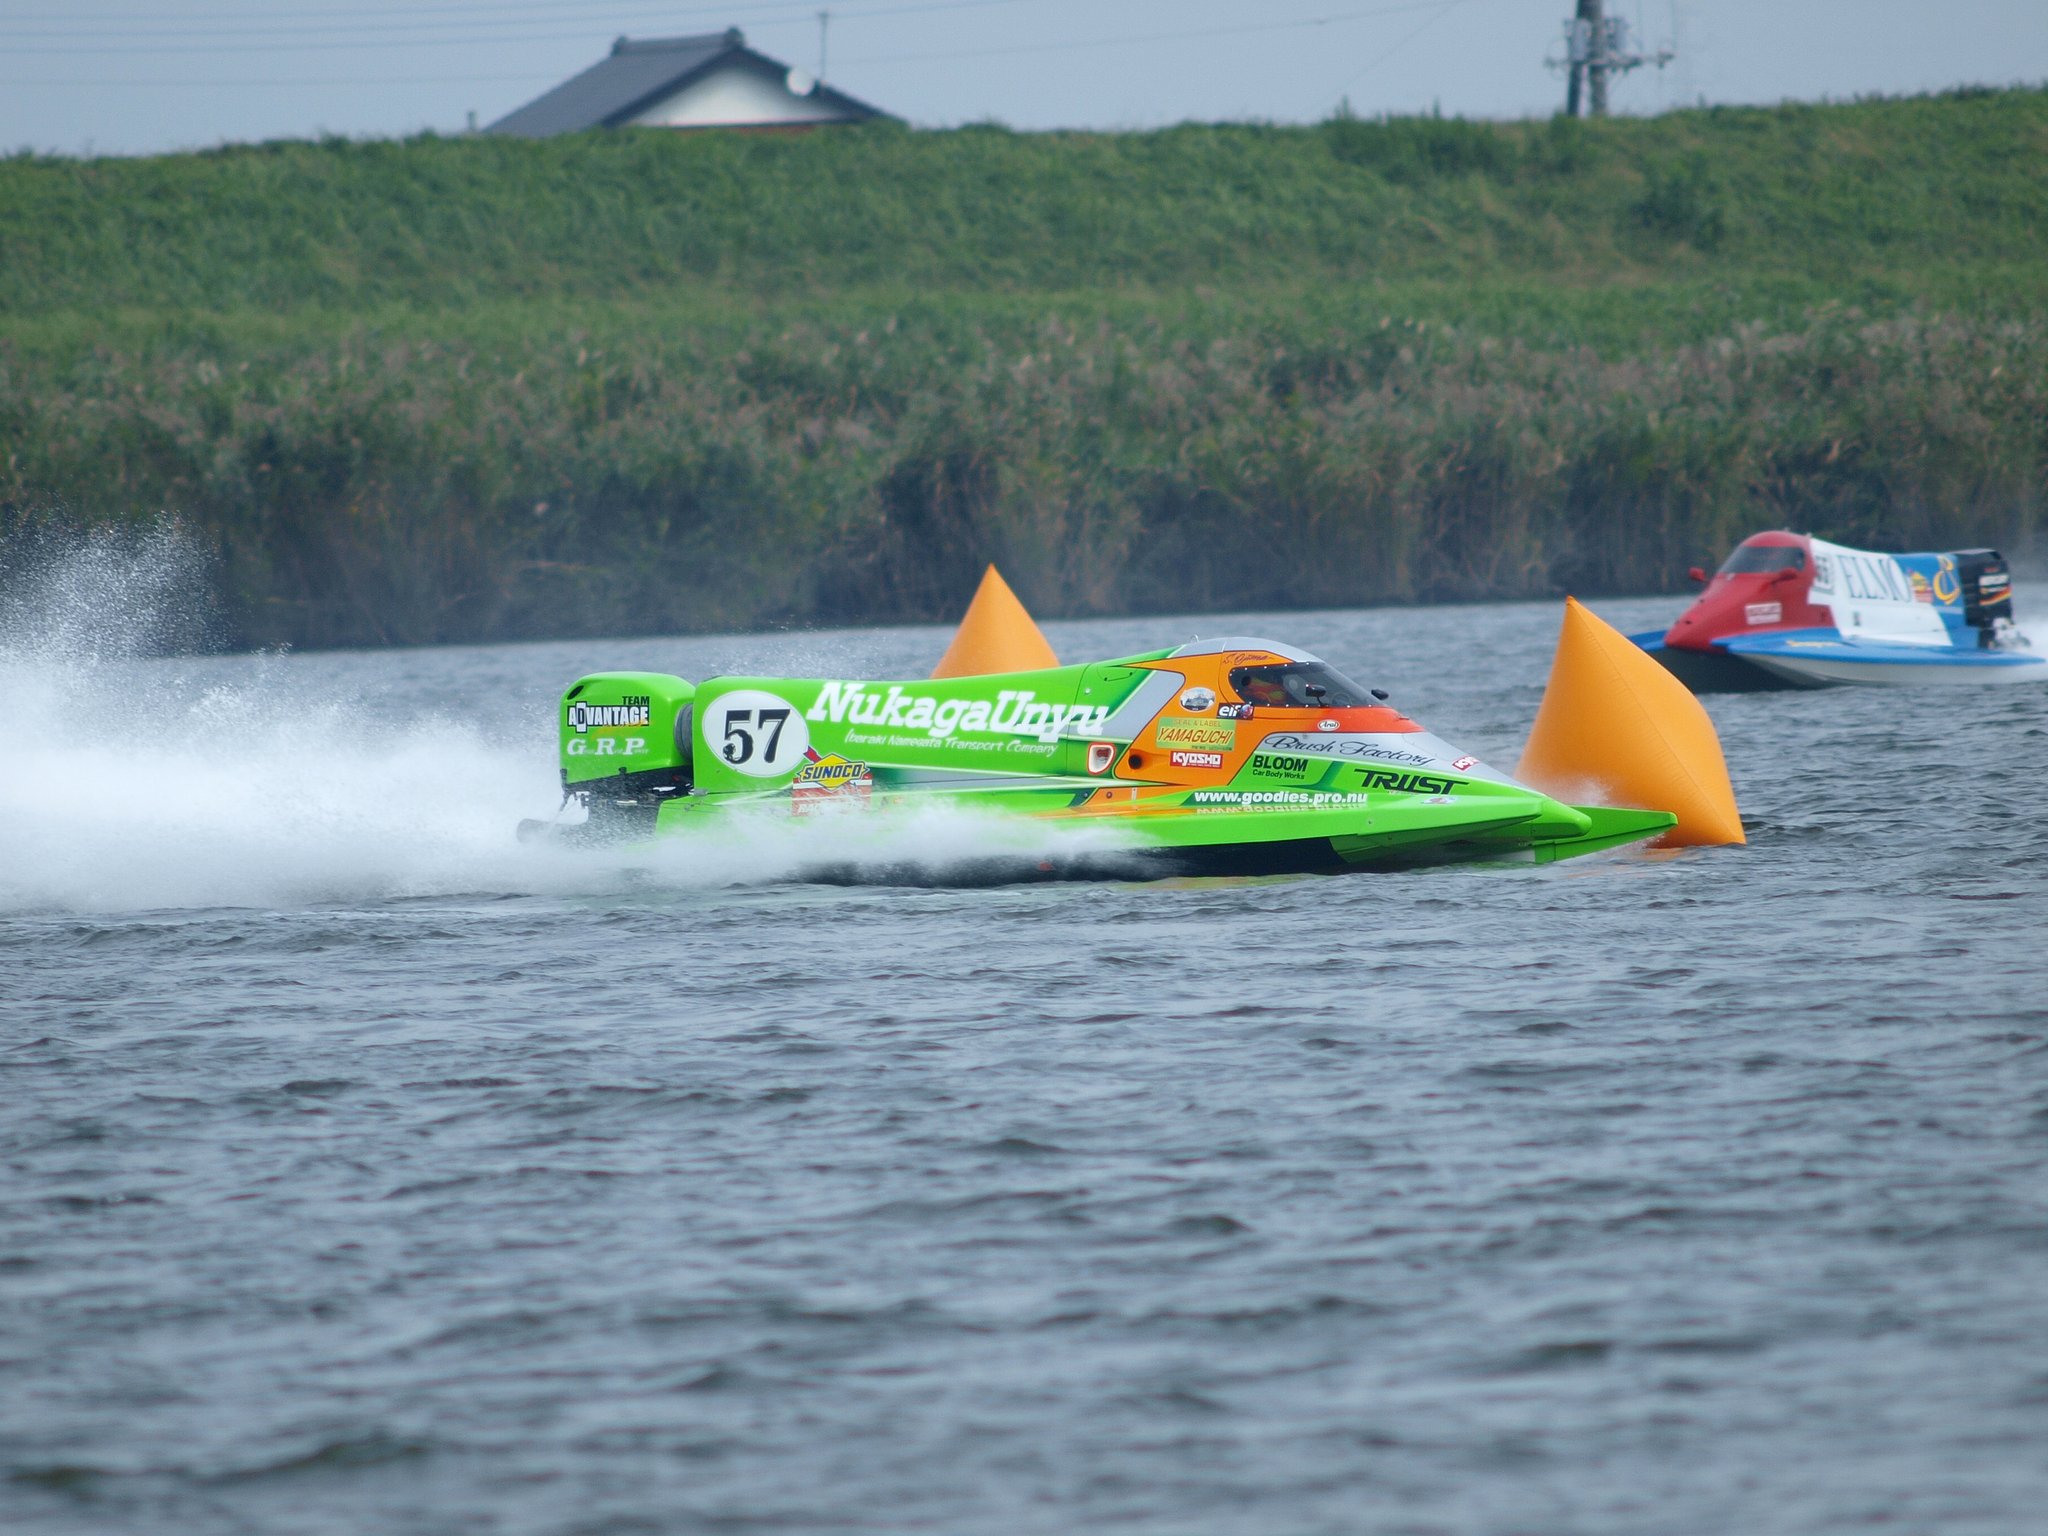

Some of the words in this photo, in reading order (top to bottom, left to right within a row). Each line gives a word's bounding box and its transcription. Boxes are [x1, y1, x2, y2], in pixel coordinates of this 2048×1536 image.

[1836, 555, 1911, 602] ELMO
[622, 696, 650, 705] TEAM
[568, 705, 649, 727] ADVANTAGE
[806, 681, 1109, 743] NukagaUnyu
[1218, 704, 1241, 717] elf
[1200, 720, 1221, 728] LABEL
[722, 709, 791, 764] 57
[844, 728, 886, 745] Ibaraki
[944, 736, 1003, 752] Transport
[1006, 739, 1058, 758] Company
[1158, 728, 1233, 745] YAMAGUCHI
[1264, 735, 1336, 755] Brush
[1337, 740, 1436, 766] Factory
[803, 764, 862, 780] SUNOCO
[1252, 755, 1308, 773] BLOOM
[1252, 769, 1265, 778] Car
[1266, 770, 1282, 781] Body
[1283, 771, 1305, 780] Works
[1354, 767, 1470, 795] TRUST
[1194, 790, 1368, 805] www.goodies.pro.nu
